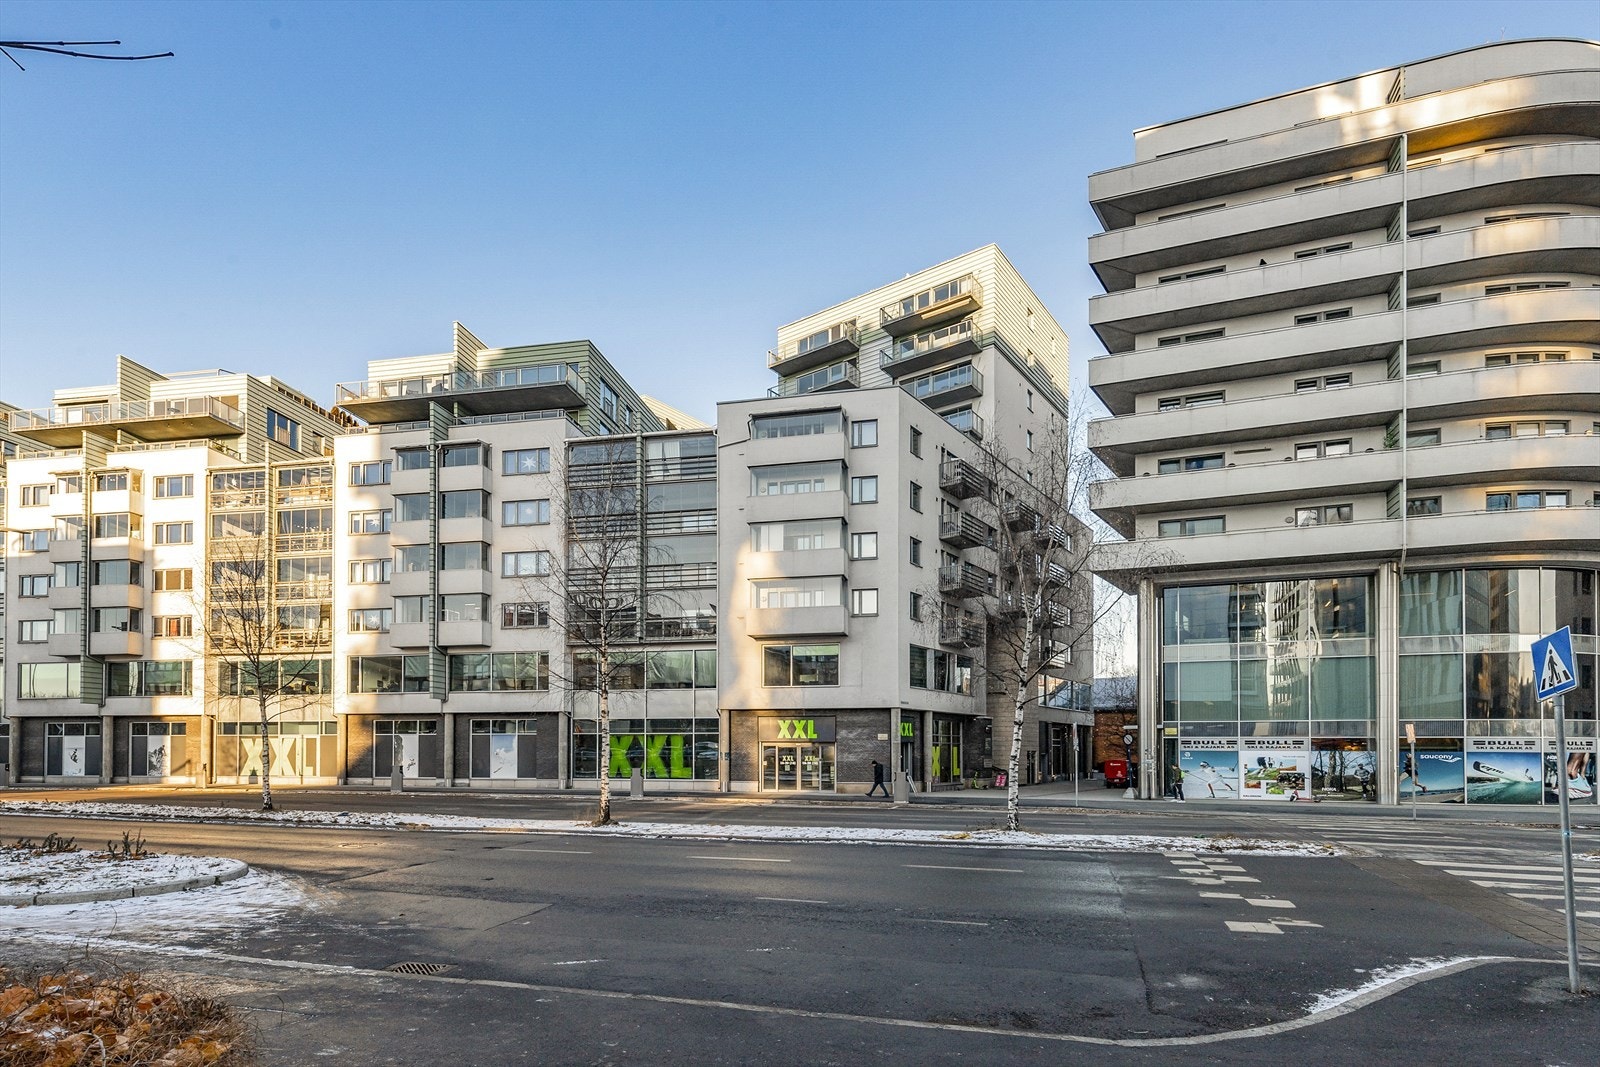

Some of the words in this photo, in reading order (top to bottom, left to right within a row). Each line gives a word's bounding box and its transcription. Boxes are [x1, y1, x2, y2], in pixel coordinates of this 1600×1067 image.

[777, 719, 818, 739] XXL
[240, 738, 314, 776] XXL
[607, 734, 692, 778] XXL
[1480, 765, 1505, 775] epic
